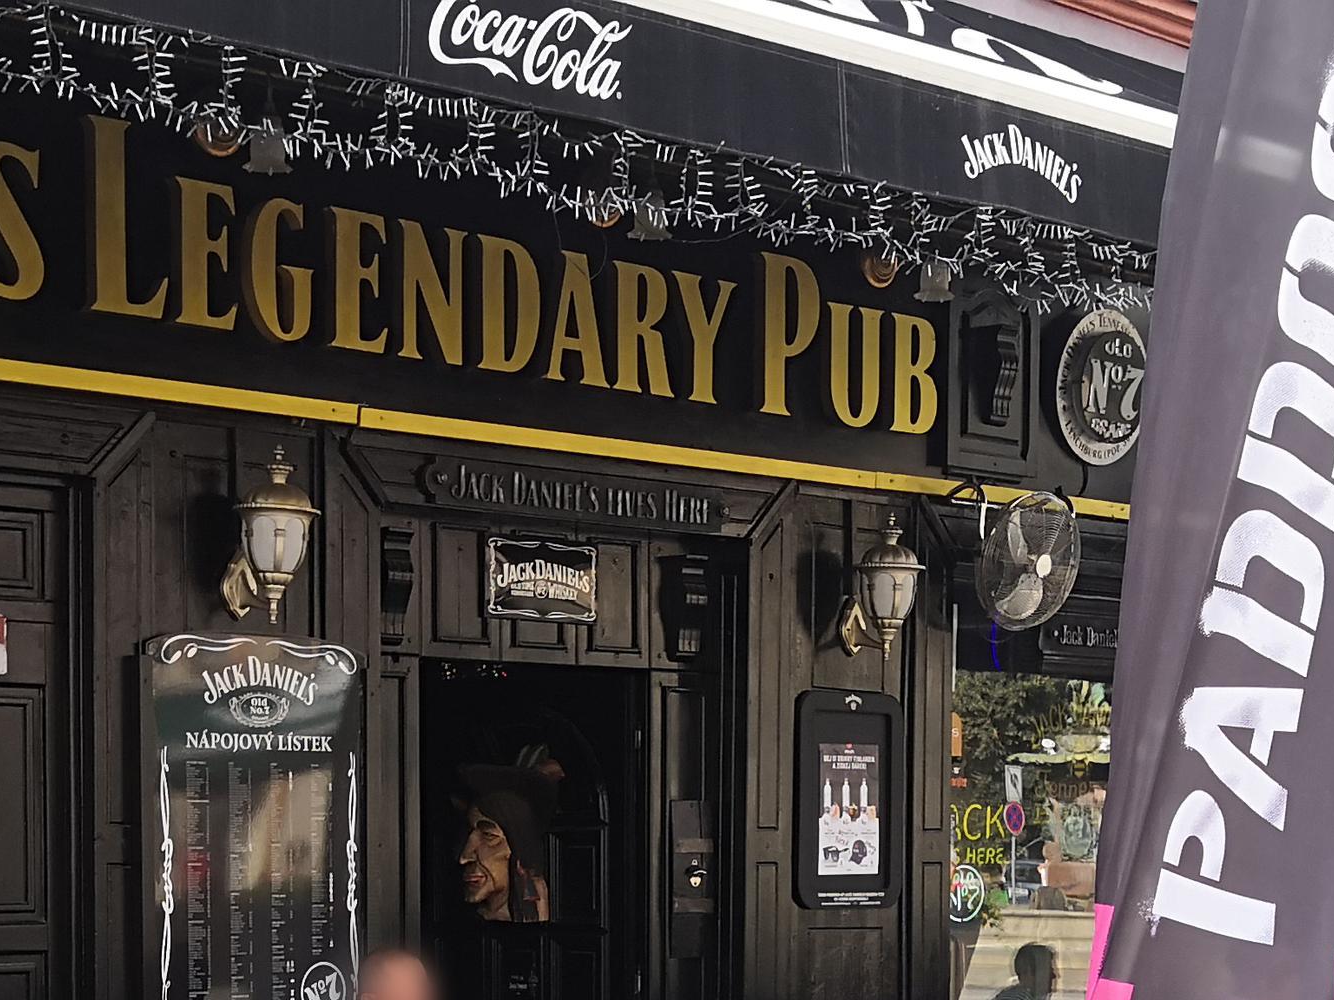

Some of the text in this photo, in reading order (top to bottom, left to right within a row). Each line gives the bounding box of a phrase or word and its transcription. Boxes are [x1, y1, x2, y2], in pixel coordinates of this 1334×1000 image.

[428, 0, 633, 100] Coca-Cola
[960, 123, 1082, 204] JACK DANIEL'S
[85, 114, 738, 405] LEGENDARY
[759, 251, 938, 434] PUB
[1105, 338, 1133, 358] OLD
[451, 464, 505, 504] JACK
[513, 471, 599, 513] DANIEL'S
[666, 489, 711, 524] HERE
[497, 562, 535, 588] JACK
[535, 559, 590, 593] DANIEL'S
[1060, 625, 1118, 648] Jack Daniel
[202, 655, 319, 706] JACK DANIEL'S
[250, 697, 268, 706] Old
[186, 729, 332, 752] NÁPOJOVÝ LÍSTEK
